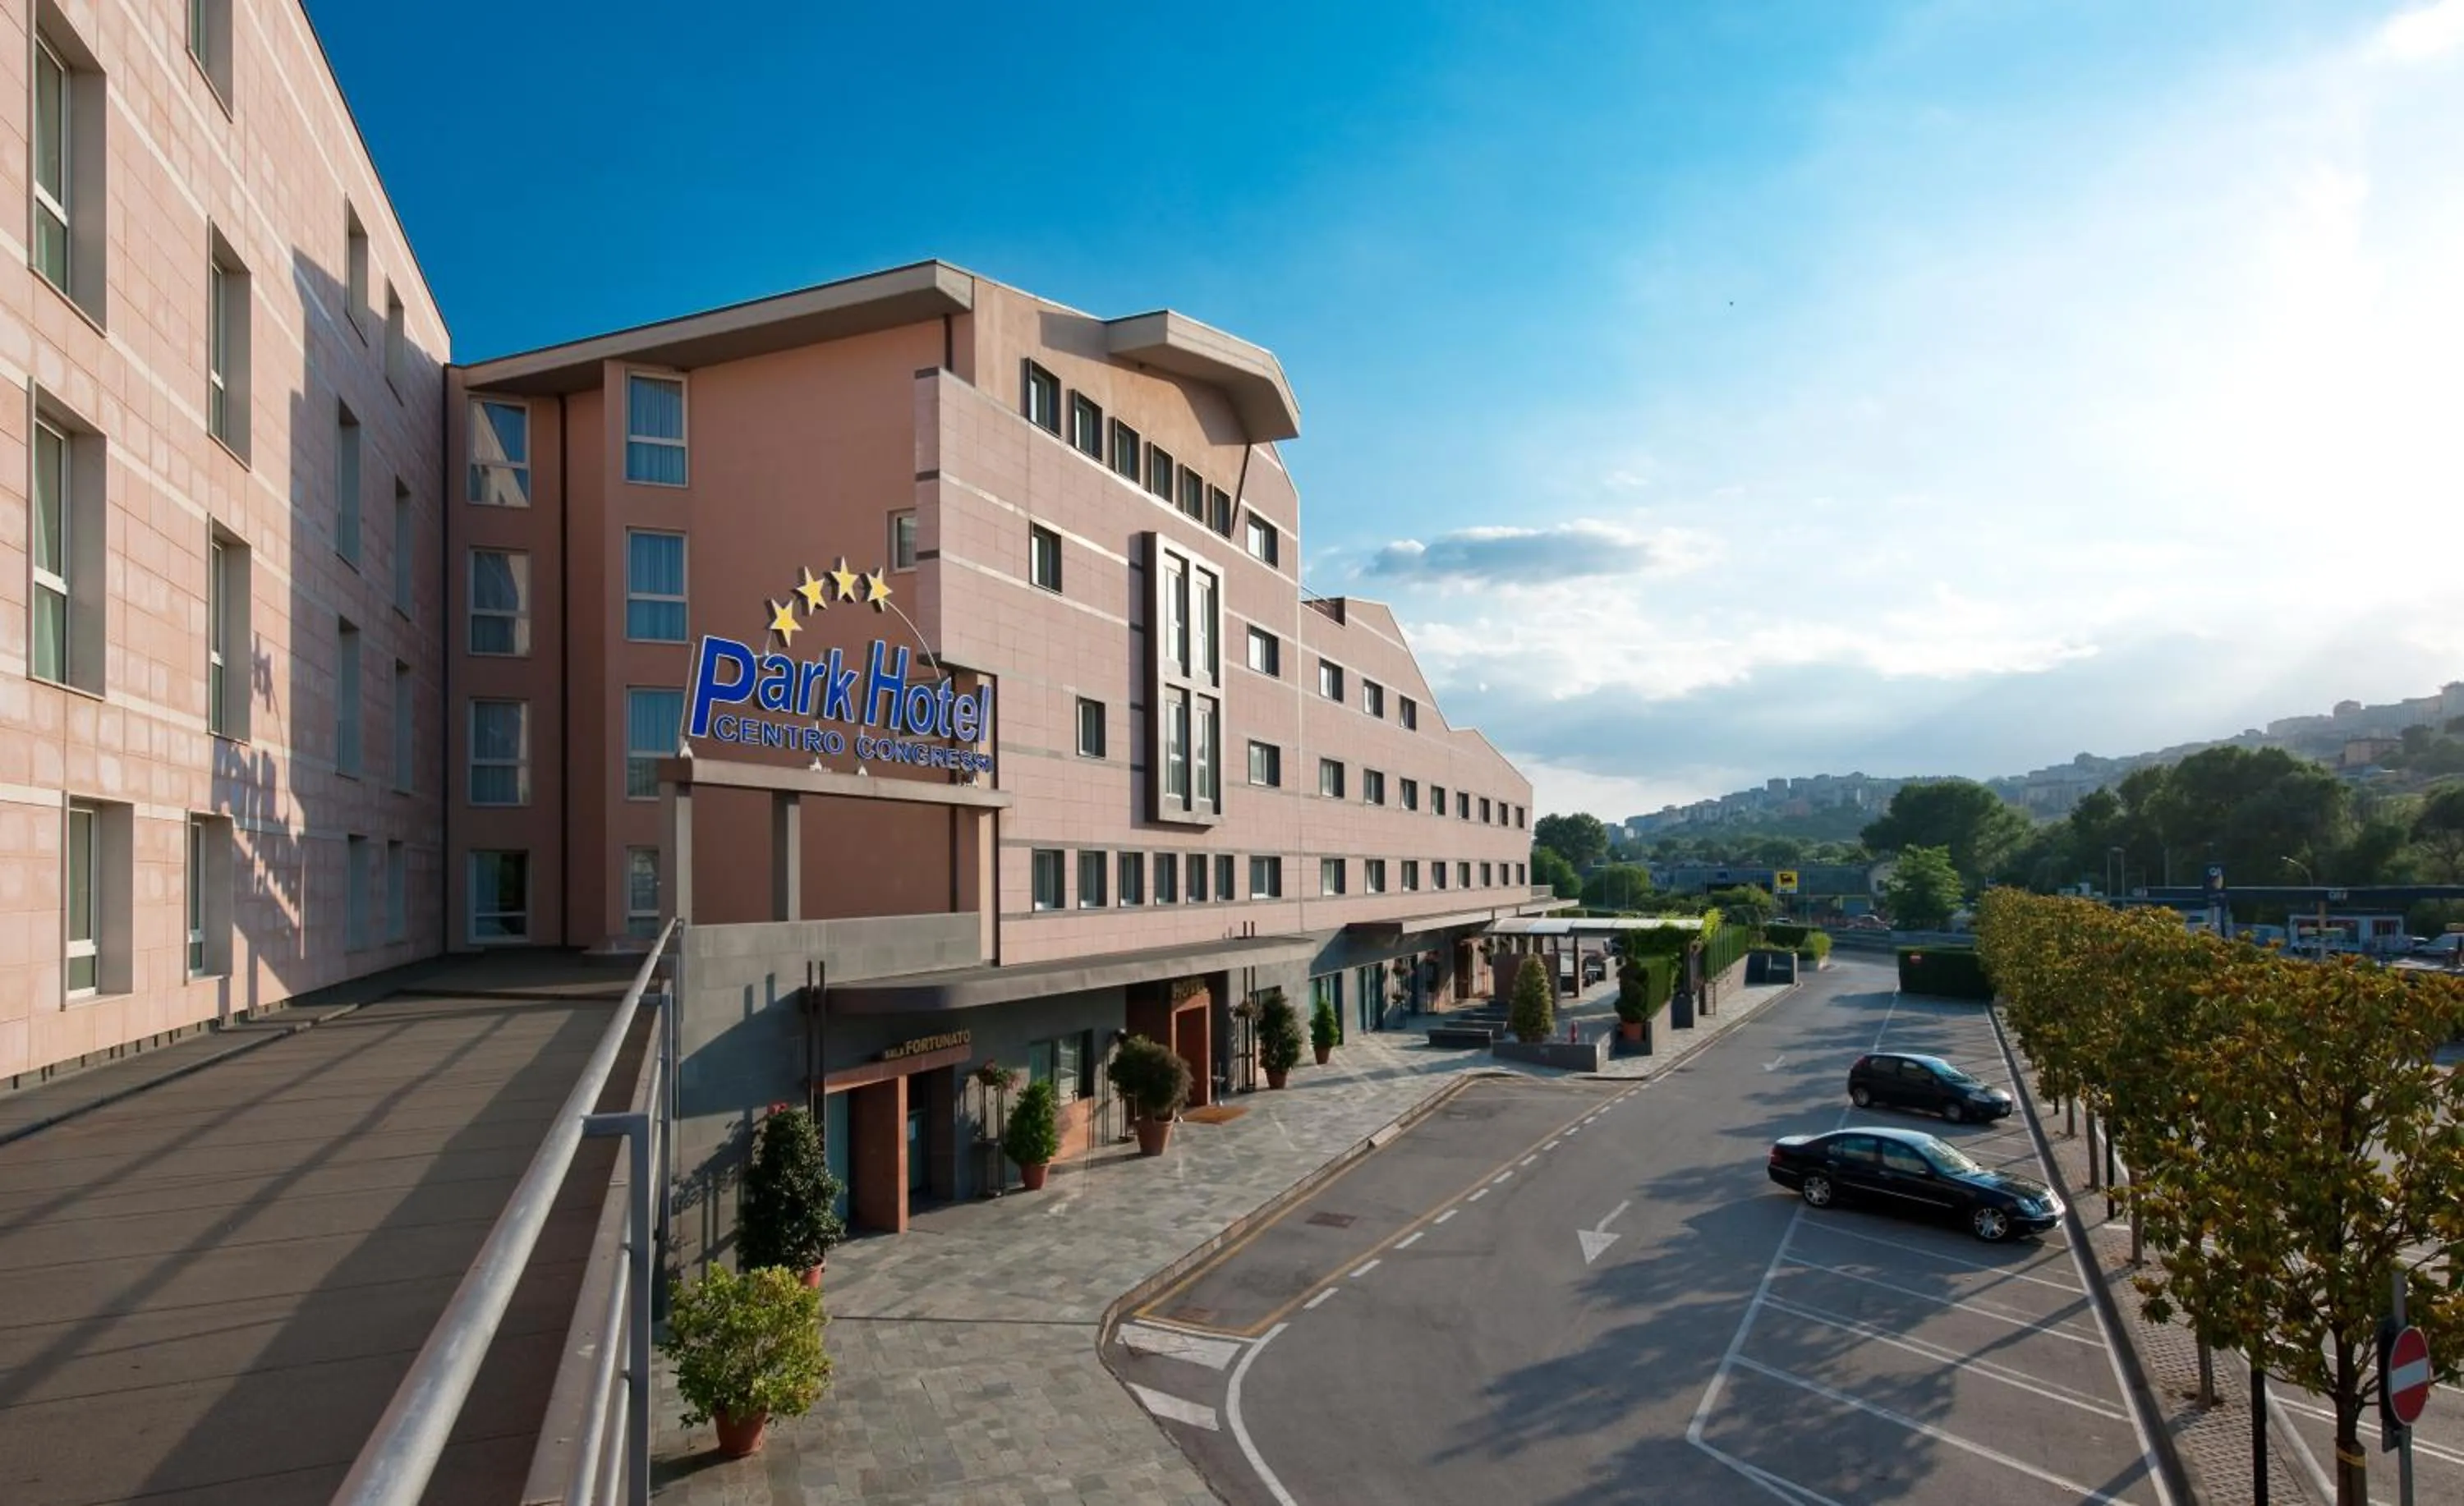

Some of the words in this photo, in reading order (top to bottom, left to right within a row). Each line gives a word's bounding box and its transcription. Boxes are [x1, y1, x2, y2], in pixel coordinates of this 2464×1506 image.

[689, 635, 859, 737] Park
[864, 639, 991, 742] Hotel
[713, 714, 845, 755] CENTRO
[855, 735, 994, 774] CONGRESSI
[905, 1029, 971, 1055] FORTUNATO
